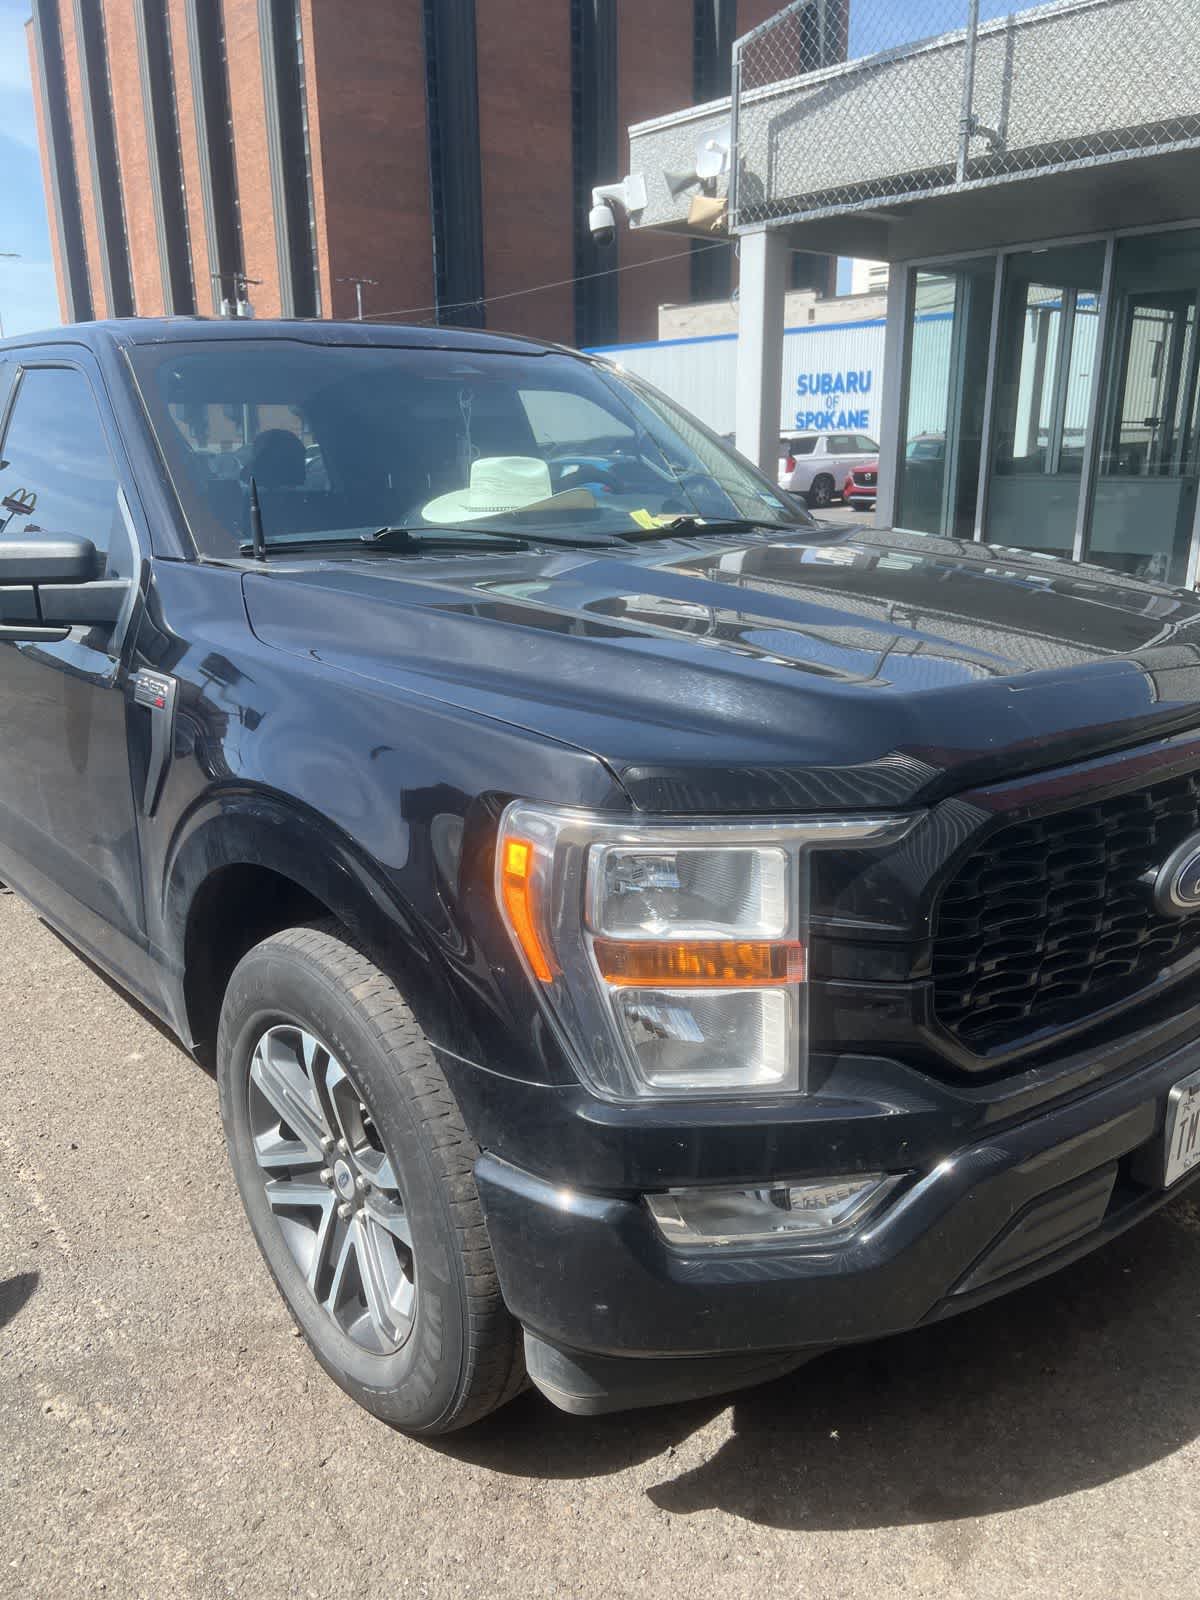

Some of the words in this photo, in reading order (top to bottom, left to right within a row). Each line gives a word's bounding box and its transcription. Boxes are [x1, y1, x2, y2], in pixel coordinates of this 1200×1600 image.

[797, 371, 872, 395] SUBARU
[826, 395, 839, 409] OF
[796, 409, 869, 430] SPOKANE
